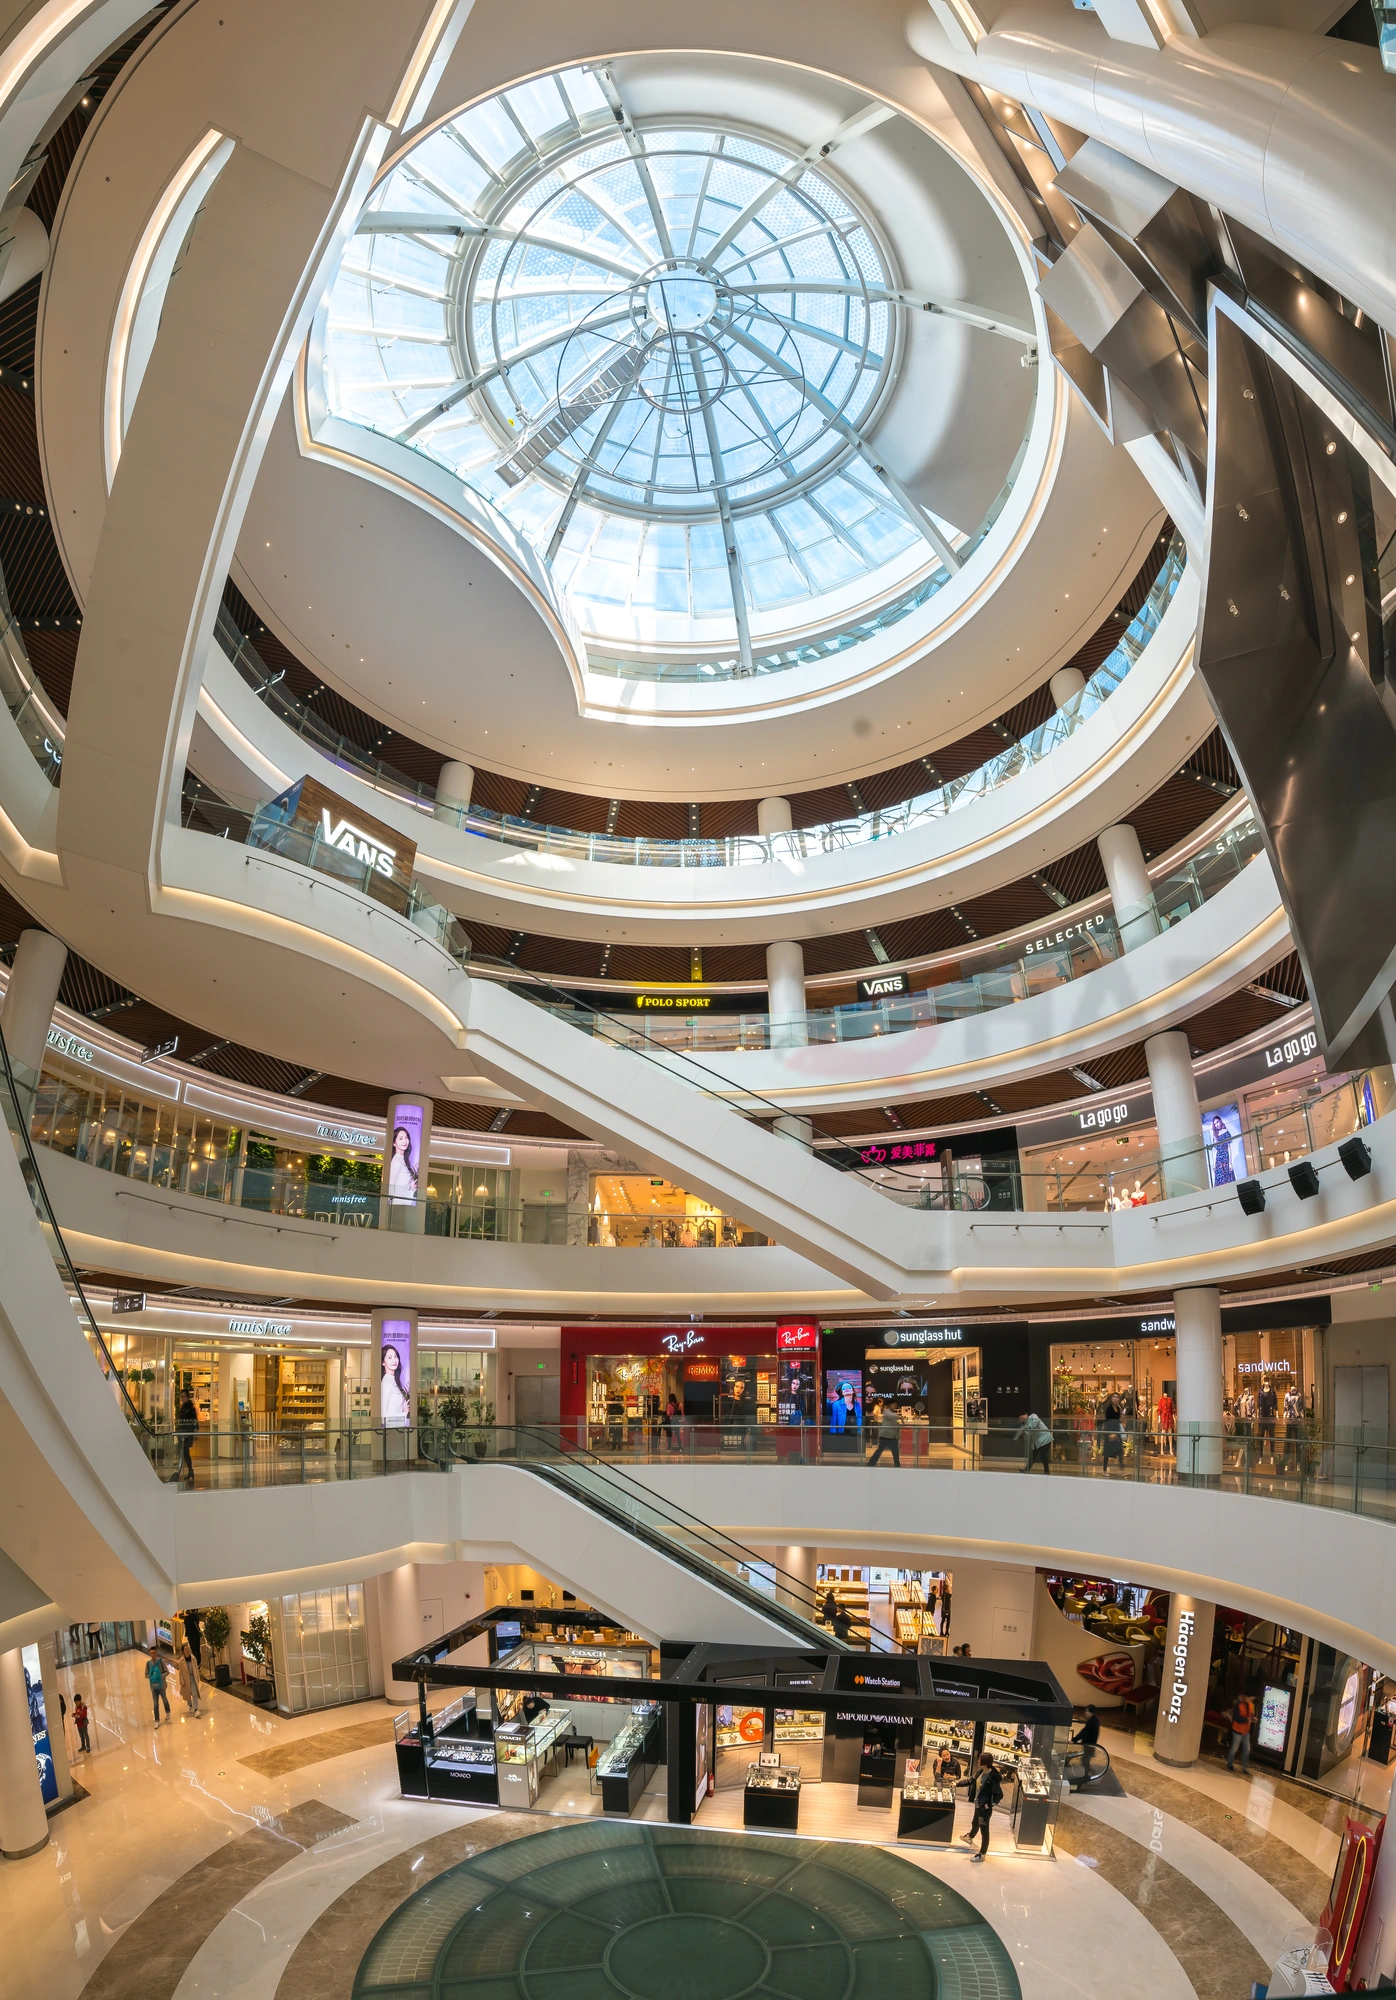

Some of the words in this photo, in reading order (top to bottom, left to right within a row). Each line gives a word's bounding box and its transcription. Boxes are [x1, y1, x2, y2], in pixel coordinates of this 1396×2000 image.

[322, 808, 396, 878] VANS
[1025, 914, 1104, 954] SELECTED
[863, 976, 903, 996] VANS
[645, 998, 673, 1007] POLO
[675, 998, 711, 1008] SPORT
[317, 1123, 377, 1146] innisfree
[332, 1195, 367, 1205] innisfree
[229, 1318, 293, 1336] innisfree
[900, 1330, 943, 1344] sunglass
[944, 1328, 962, 1341] hut
[879, 1364, 904, 1373] sunglass
[904, 1364, 914, 1372] hut
[571, 1650, 607, 1658] COACH
[864, 1676, 881, 1686] Watch
[881, 1678, 901, 1687] Station
[836, 1712, 873, 1722] EMPORIO
[882, 1715, 914, 1725] ARMANI
